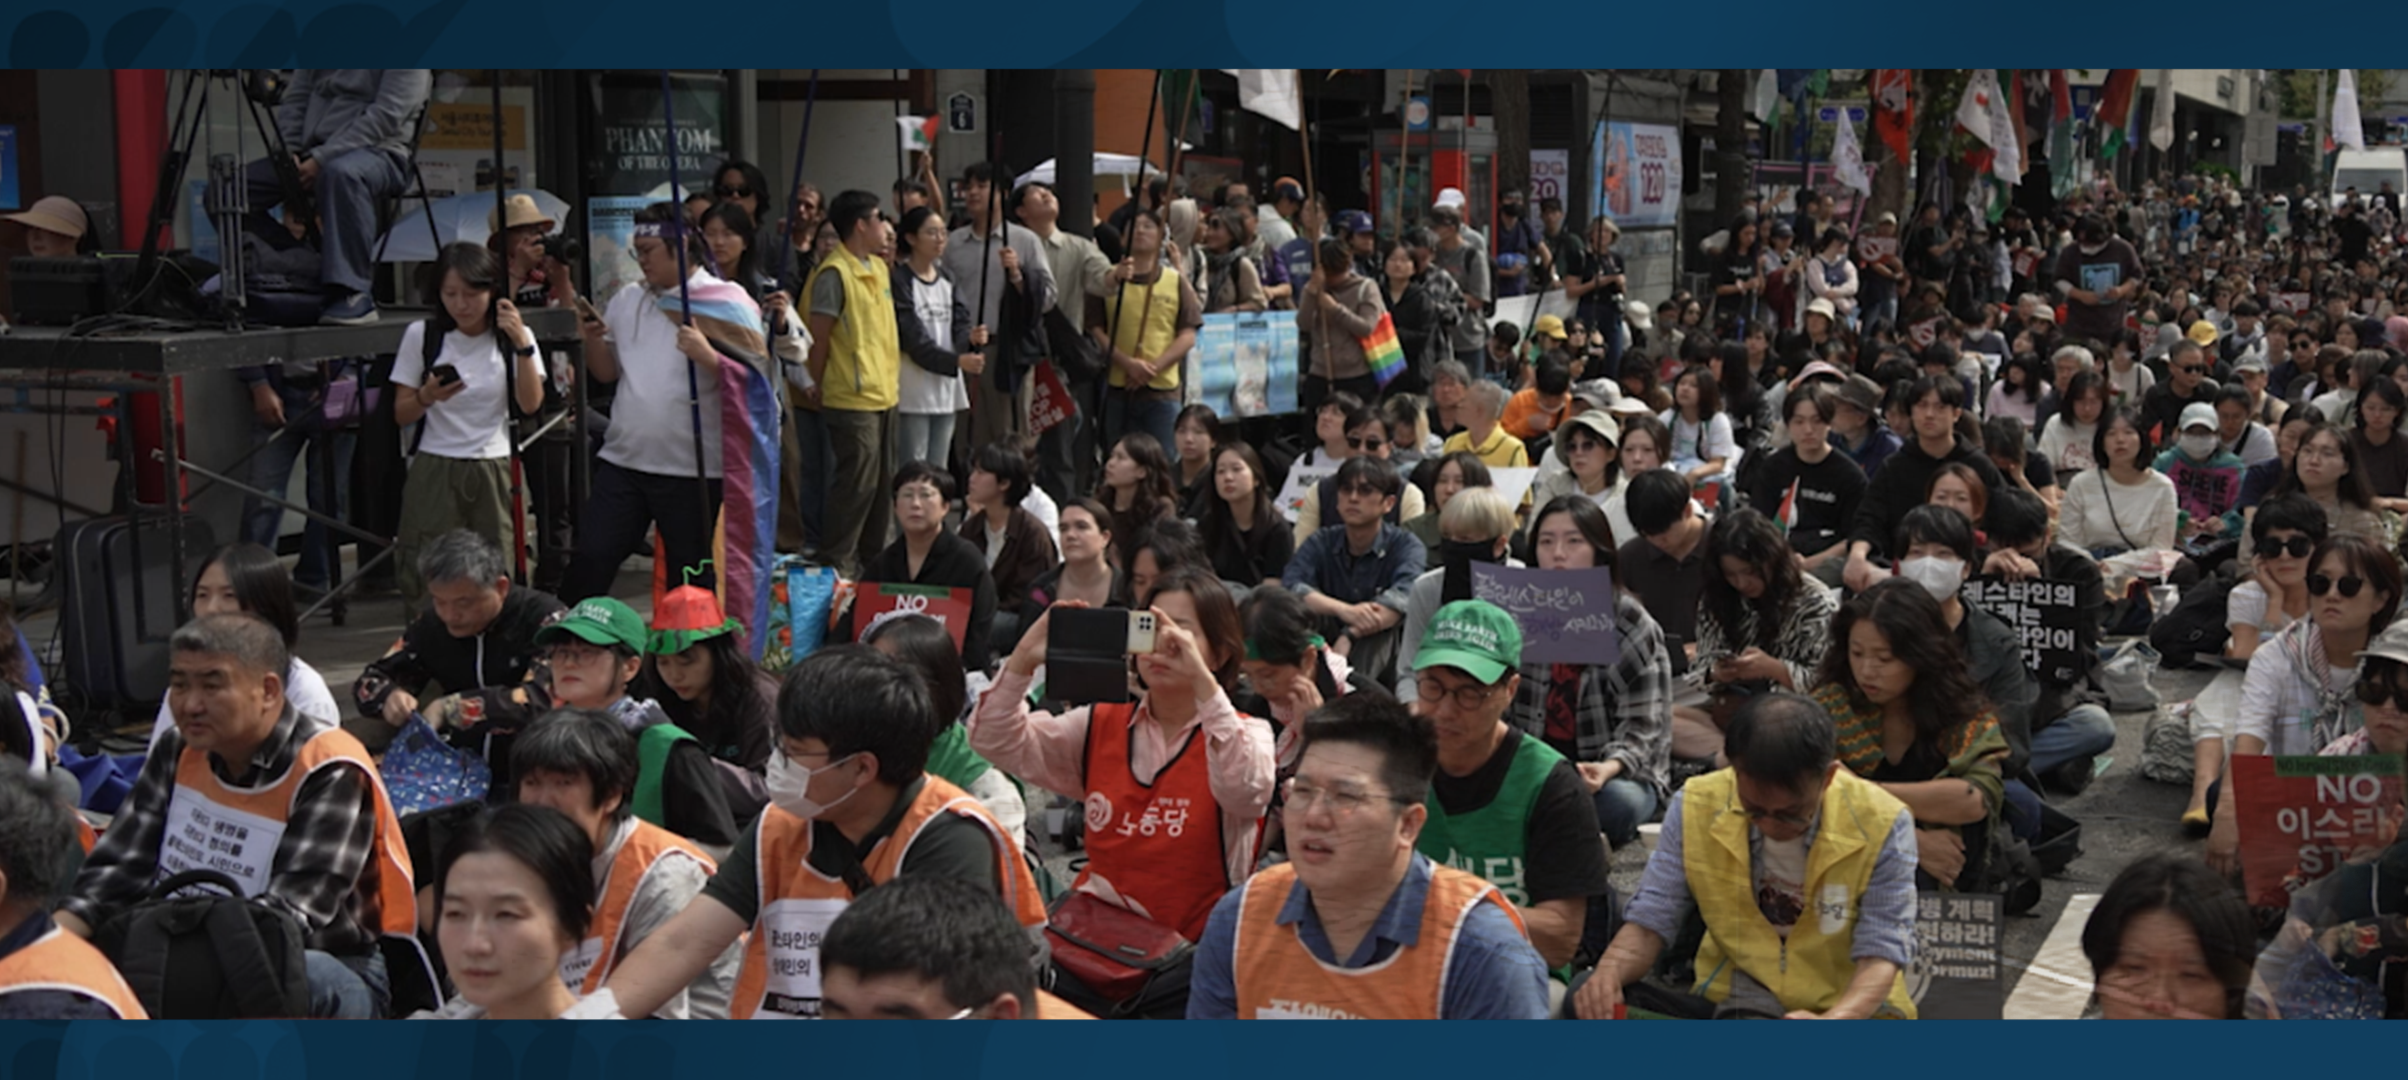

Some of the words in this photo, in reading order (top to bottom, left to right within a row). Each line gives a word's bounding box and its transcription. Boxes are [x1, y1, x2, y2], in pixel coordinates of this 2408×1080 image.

[604, 127, 712, 153] PHANOM
[618, 155, 635, 170] OF
[637, 155, 659, 170] THE
[661, 155, 702, 171] OERA
[1530, 178, 1559, 202] 20
[894, 593, 929, 613] NO
[1961, 580, 2075, 607] 레스타인의
[2316, 772, 2382, 804] NO
[1116, 806, 1190, 837] 노동당
[2276, 806, 2390, 842] 이스라
